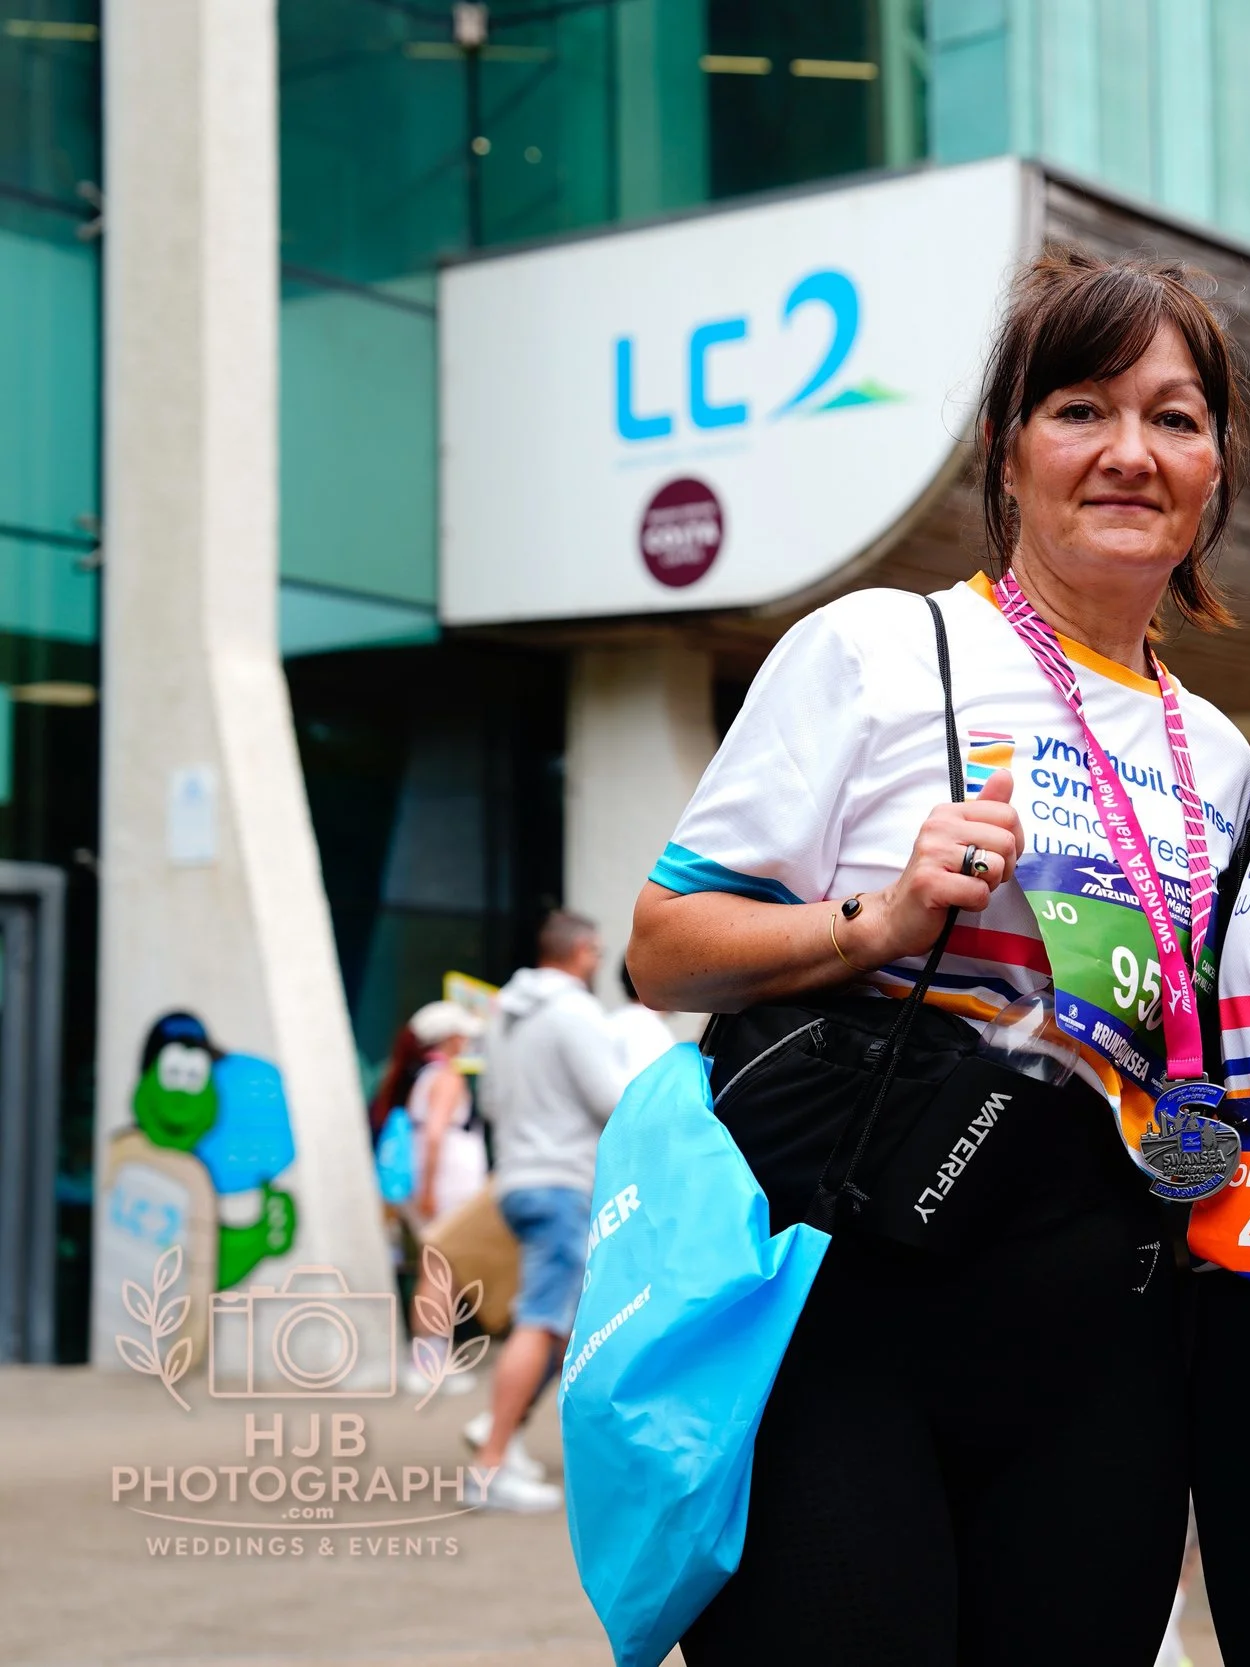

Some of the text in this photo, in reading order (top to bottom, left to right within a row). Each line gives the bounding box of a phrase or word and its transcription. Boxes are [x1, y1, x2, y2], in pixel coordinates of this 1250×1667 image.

[1032, 800, 1108, 840] canc
[1106, 811, 1138, 851] Half
[1041, 897, 1079, 926] JO
[1127, 852, 1177, 955] SWANSEA
[913, 1092, 1013, 1225] WATERFLY
[1162, 1149, 1226, 1166] SWANSEA
[562, 1282, 652, 1393] rontRunner
